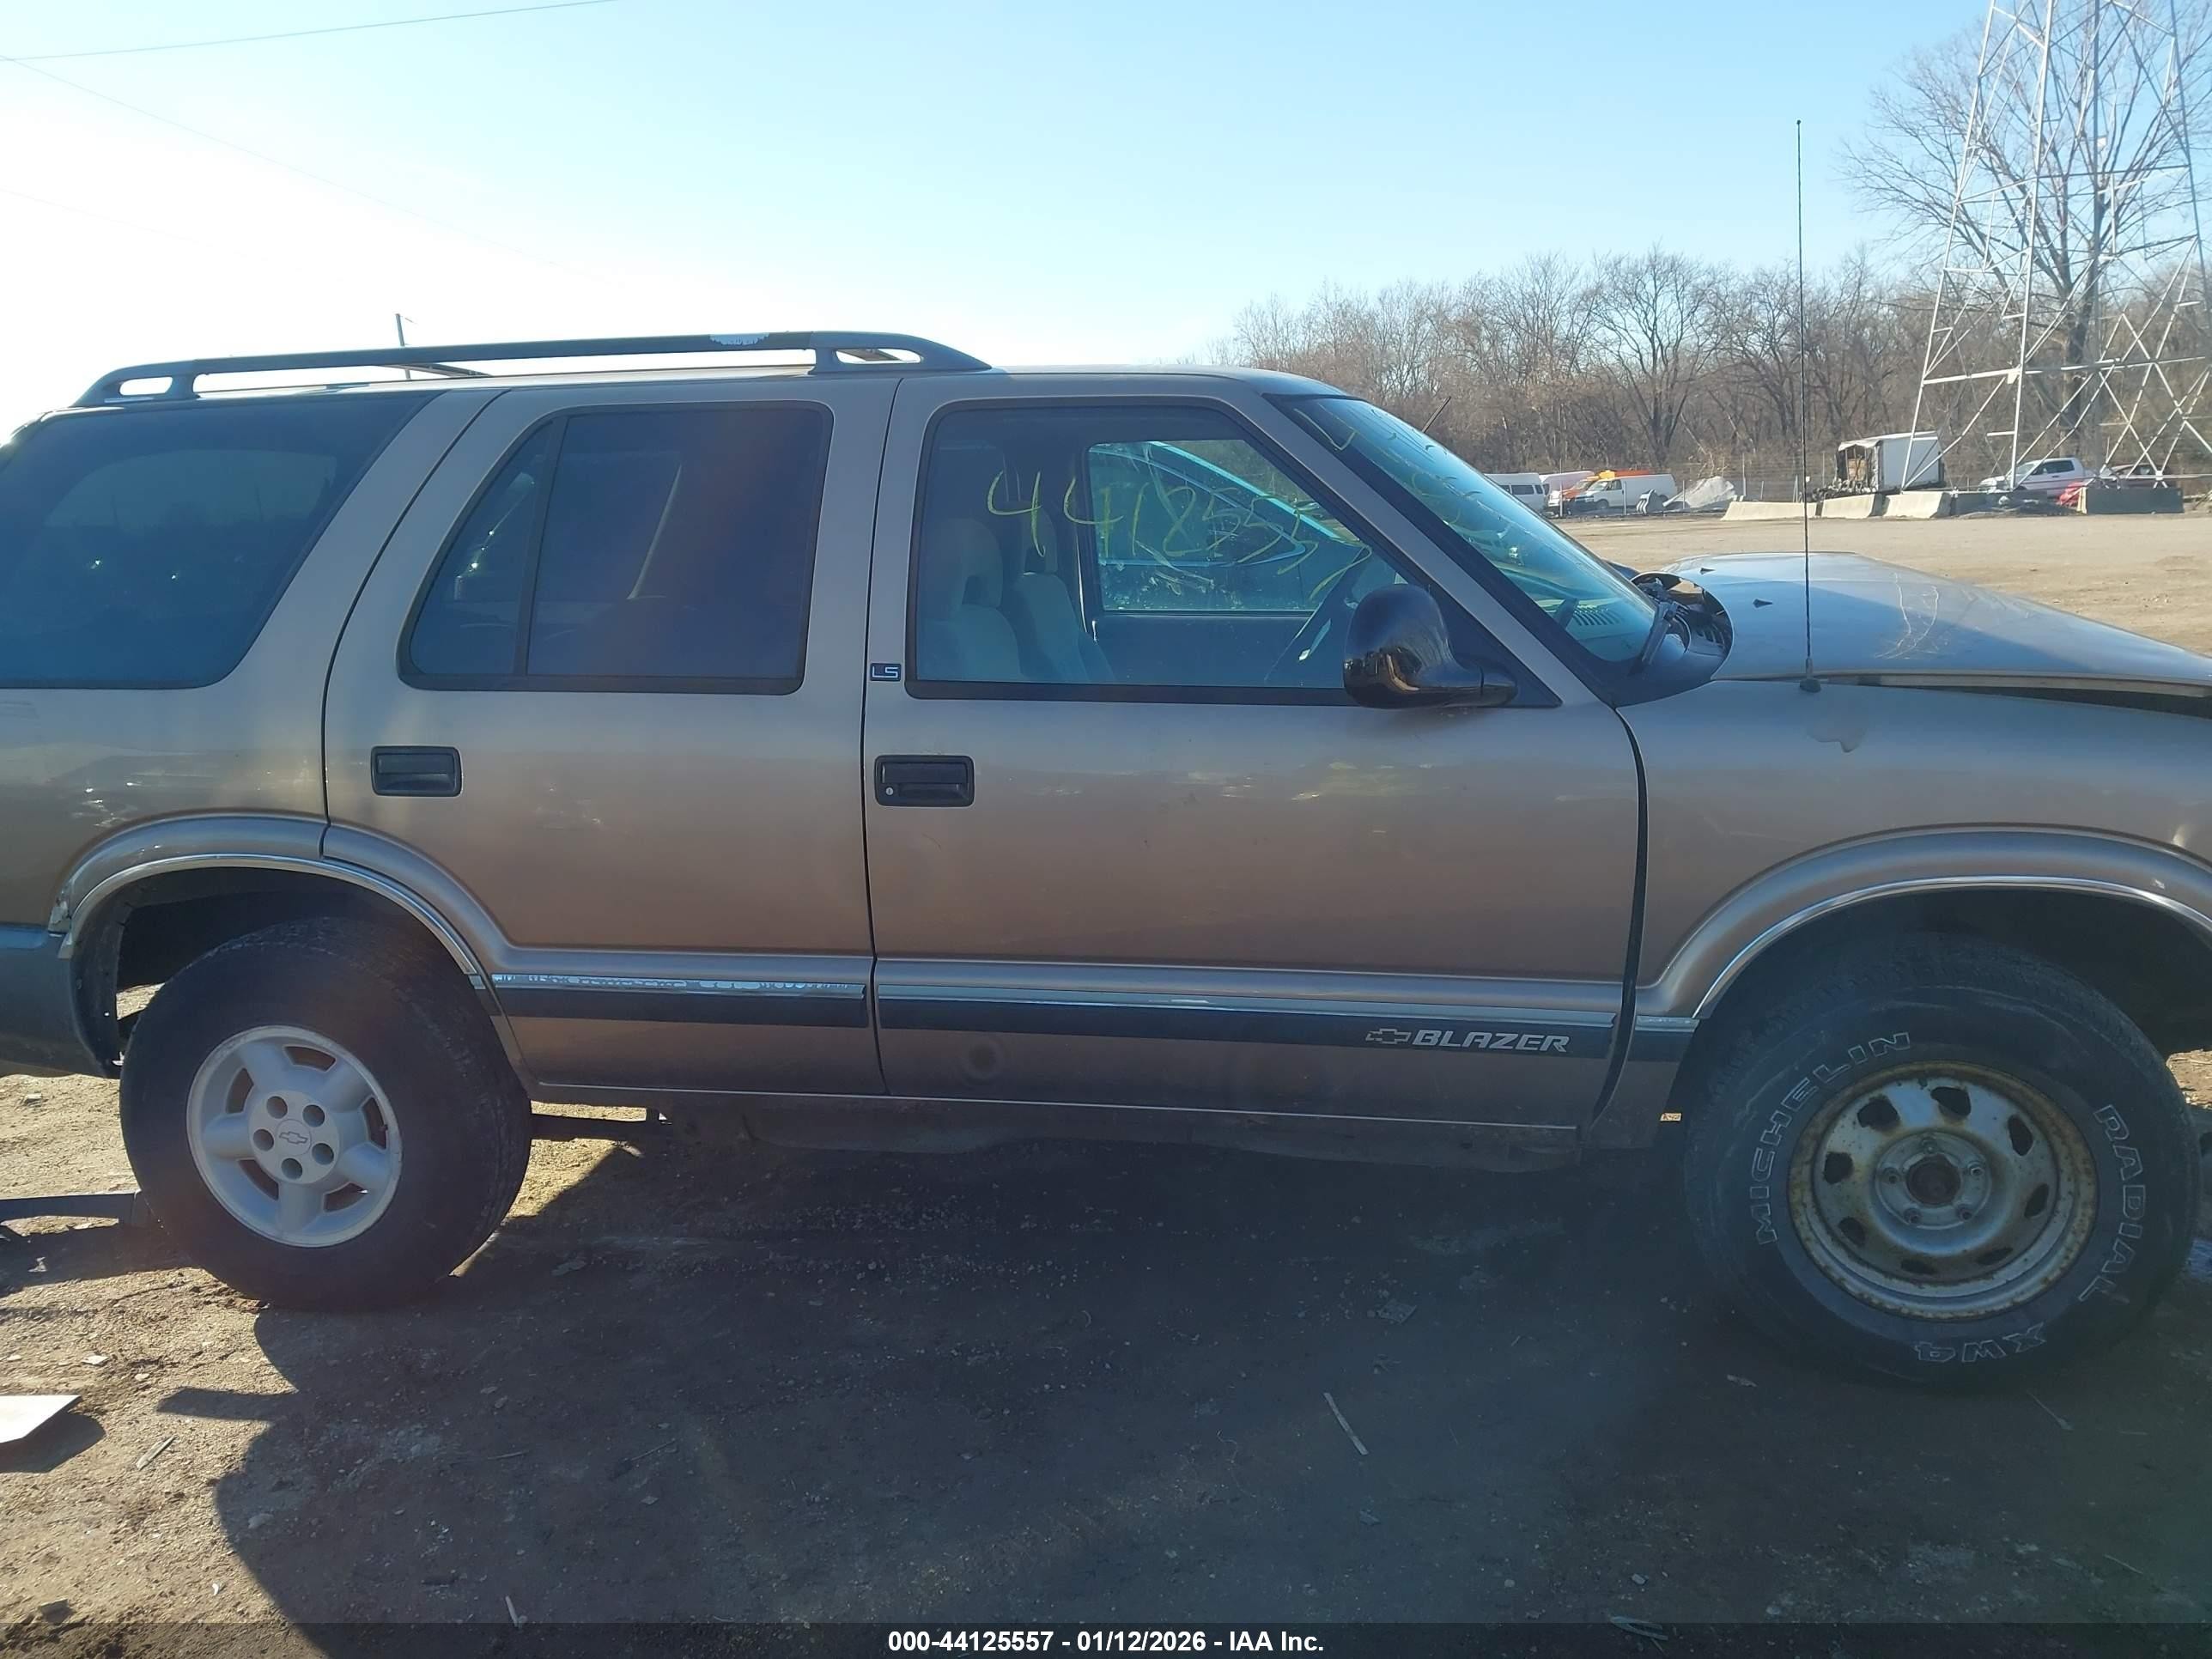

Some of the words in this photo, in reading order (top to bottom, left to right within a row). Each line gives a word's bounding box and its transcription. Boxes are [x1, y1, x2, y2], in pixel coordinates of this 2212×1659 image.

[872, 665, 899, 678] LS
[1413, 1030, 1570, 1052] BLAZER
[1750, 1032, 1911, 1244] MICHELIN
[2078, 1104, 2146, 1303] RADIAL
